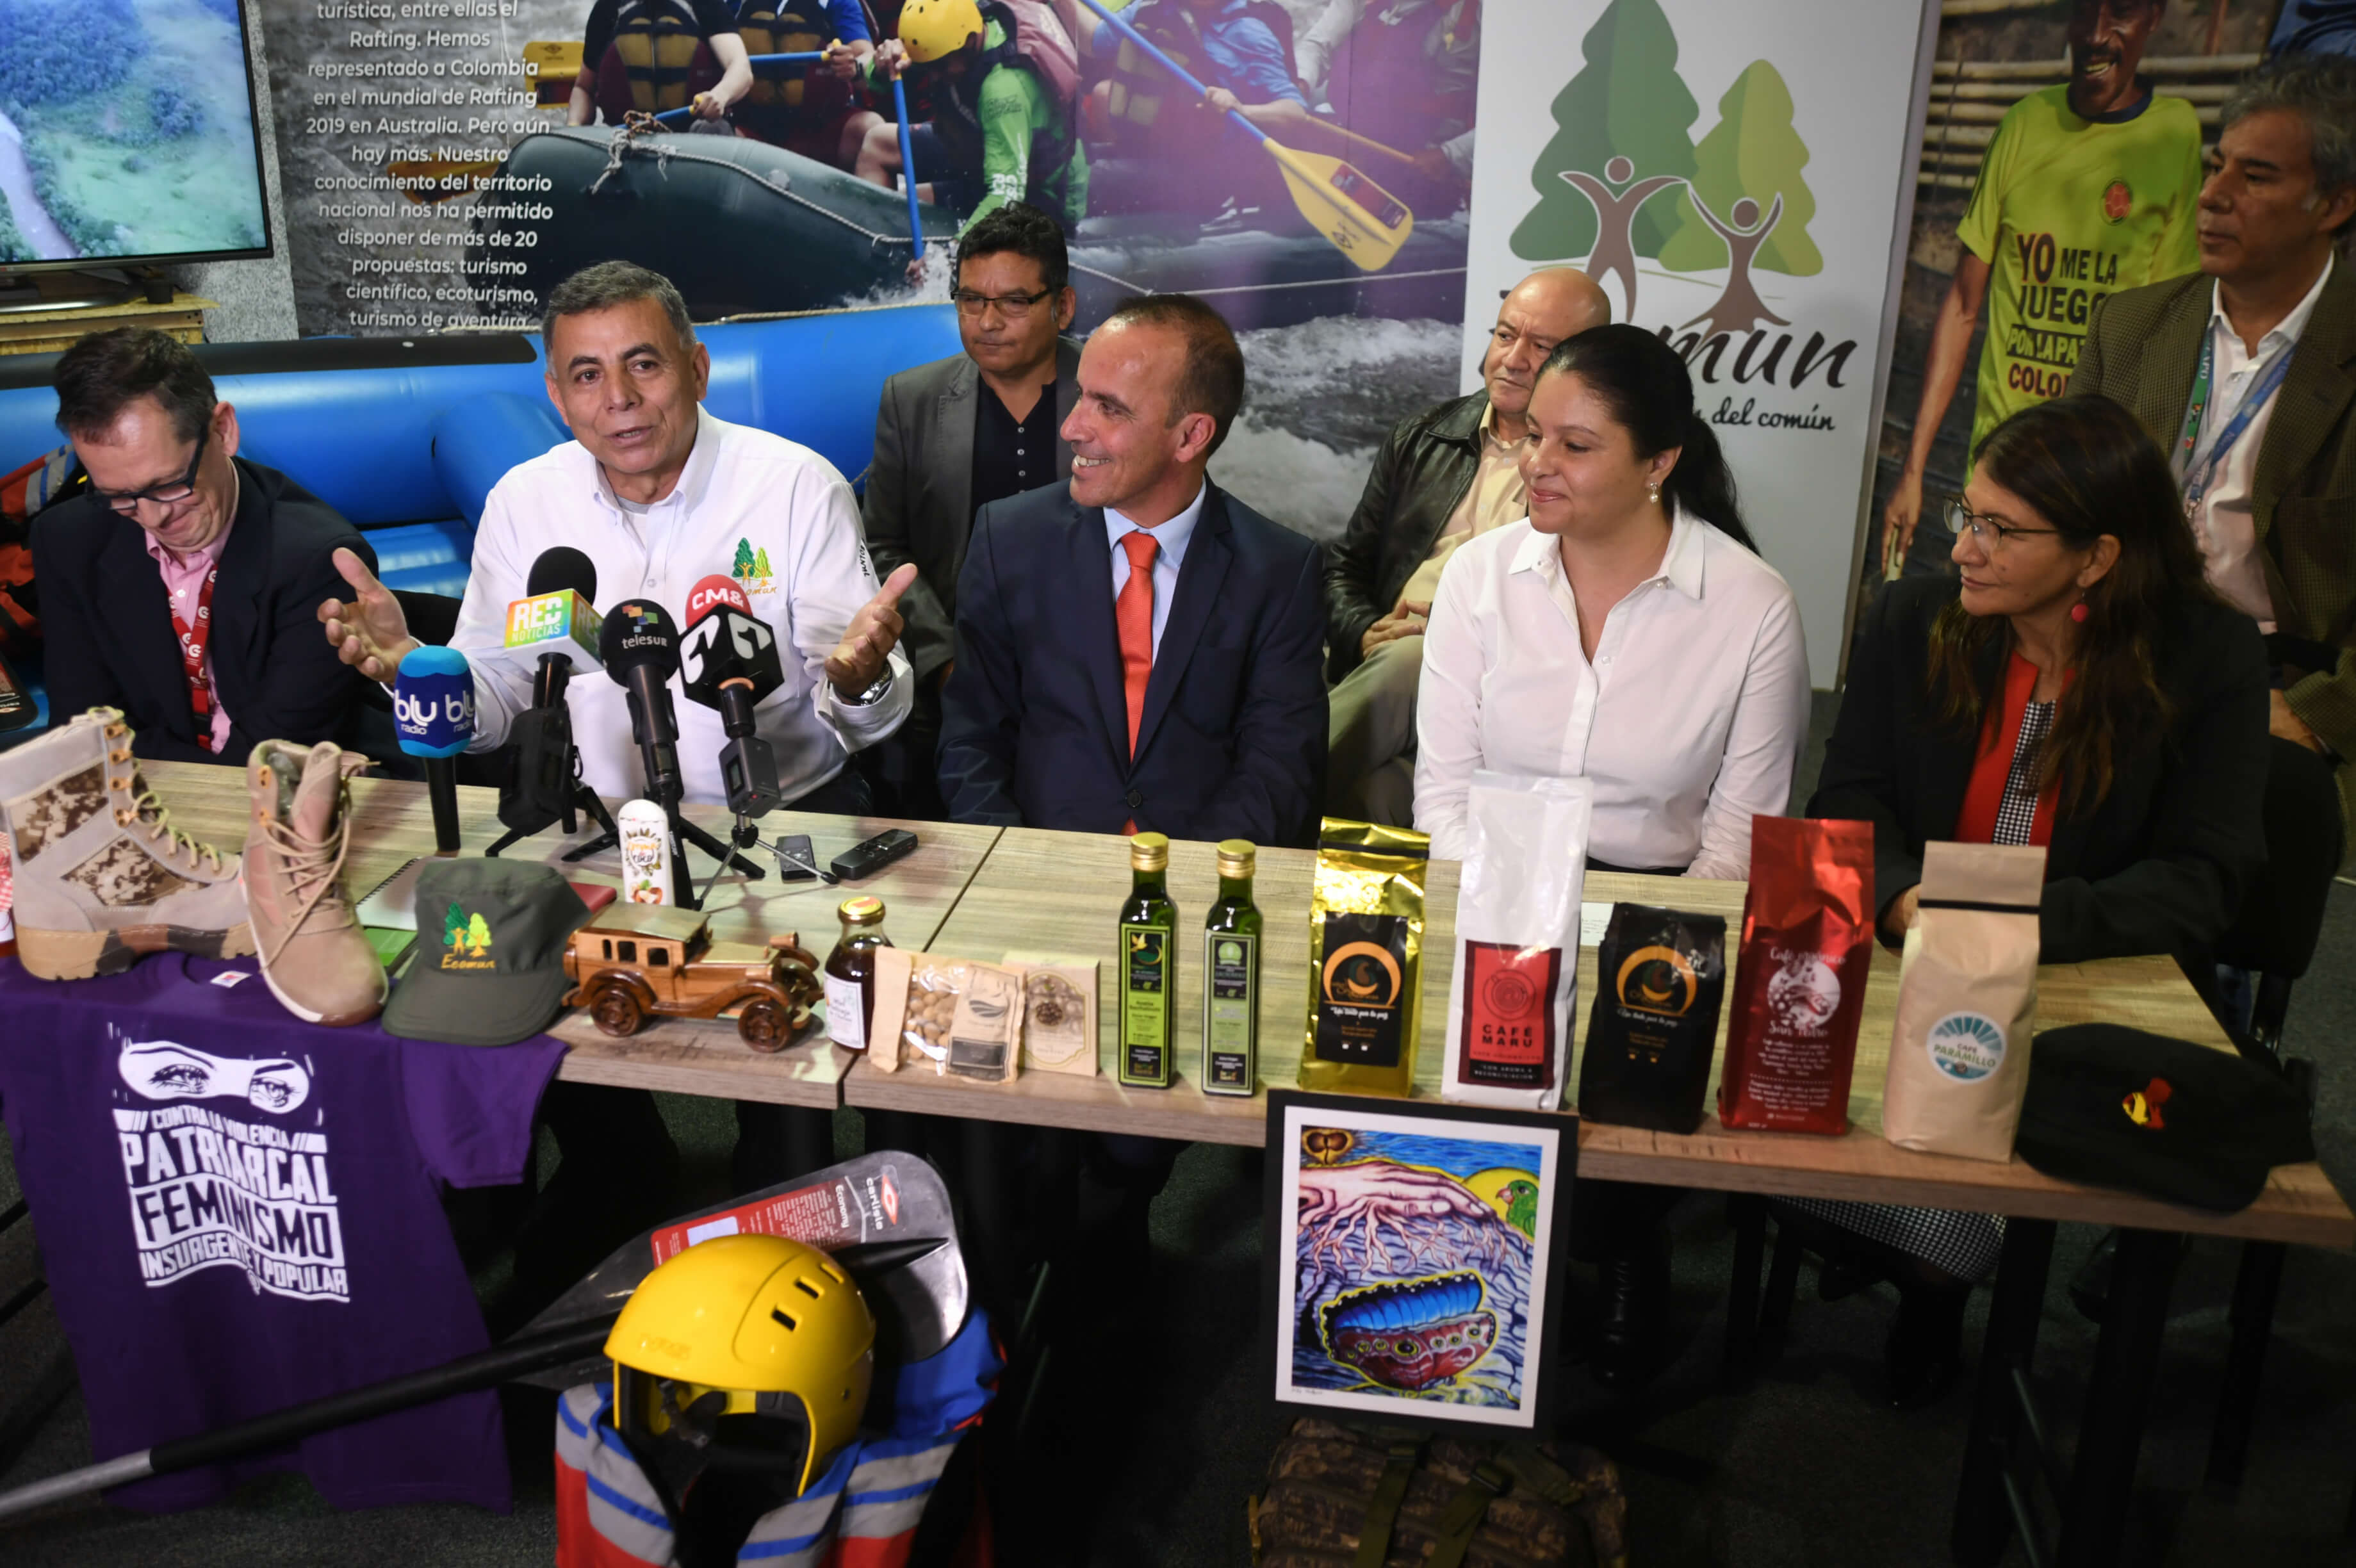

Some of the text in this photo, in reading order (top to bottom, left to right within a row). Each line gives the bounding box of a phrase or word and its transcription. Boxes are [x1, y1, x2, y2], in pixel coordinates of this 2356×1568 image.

[317, 0, 518, 20] turística, entre ellas el
[350, 30, 491, 51] Rafting. Hemos
[308, 58, 539, 81] representado a Colombia
[313, 88, 539, 110] en el mundial de Rafting
[306, 117, 550, 134] 2019 en Australia. Pero aún
[352, 145, 509, 165] hay más. Nuestro
[315, 172, 553, 192] conocimiento del territorio
[318, 200, 553, 225] nacional nos ha permitido
[338, 227, 538, 248] disponer de más de 20
[352, 258, 527, 275] propuestas: turismo
[2017, 233, 2118, 286] YO ME LA
[346, 284, 539, 305] científico, ecoturismo,
[349, 311, 527, 329] turismo de aventura
[2008, 362, 2070, 399] COLO
[1712, 396, 1755, 425] del
[1758, 404, 1836, 431] común
[691, 587, 744, 610] CM&
[513, 596, 562, 632] RED
[512, 623, 561, 642] NOTICIAS
[394, 689, 438, 727] blu
[400, 724, 427, 735] radio
[1482, 1035, 1533, 1047] MARU
[1933, 1043, 1996, 1067] PARAMILLO
[151, 1104, 291, 1151] CONTRA LA VIOLENCIA
[119, 1125, 338, 1205] PATRIARCAL
[835, 1184, 849, 1229] Economy
[865, 1177, 883, 1230] carlisle
[136, 1179, 333, 1260] FEMINISMO
[139, 1232, 254, 1279] INSURGENTE
[263, 1259, 348, 1294] POPULAR
